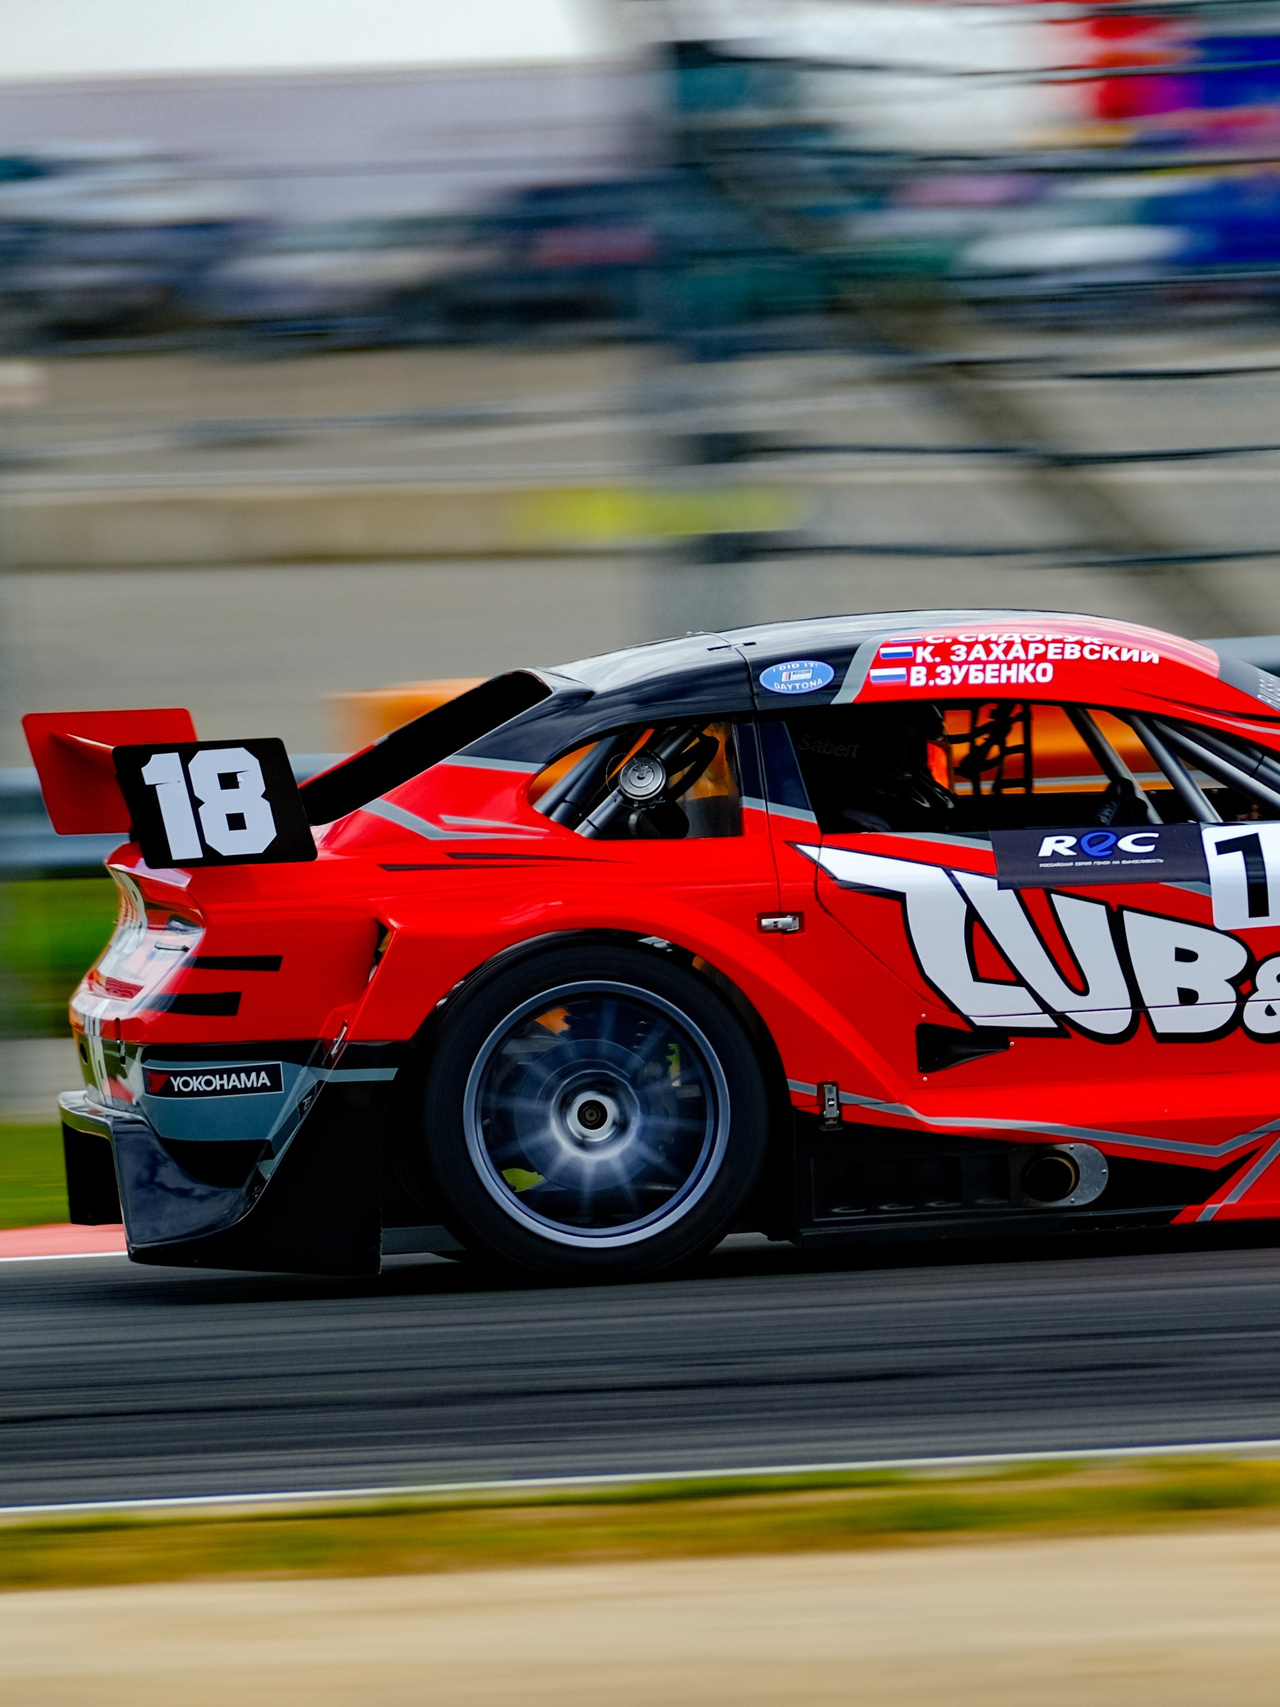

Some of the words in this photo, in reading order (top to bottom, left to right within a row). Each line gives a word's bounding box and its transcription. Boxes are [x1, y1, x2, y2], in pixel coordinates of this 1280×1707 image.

[915, 646, 942, 663] К.
[950, 643, 1160, 664] ЗАХАРЕВСКИЙ
[774, 678, 823, 690] DAYTONA
[910, 662, 1054, 687] В.ЗУБЕНКО
[141, 747, 277, 860] 18
[170, 1071, 271, 1092] YOKOHAMA
